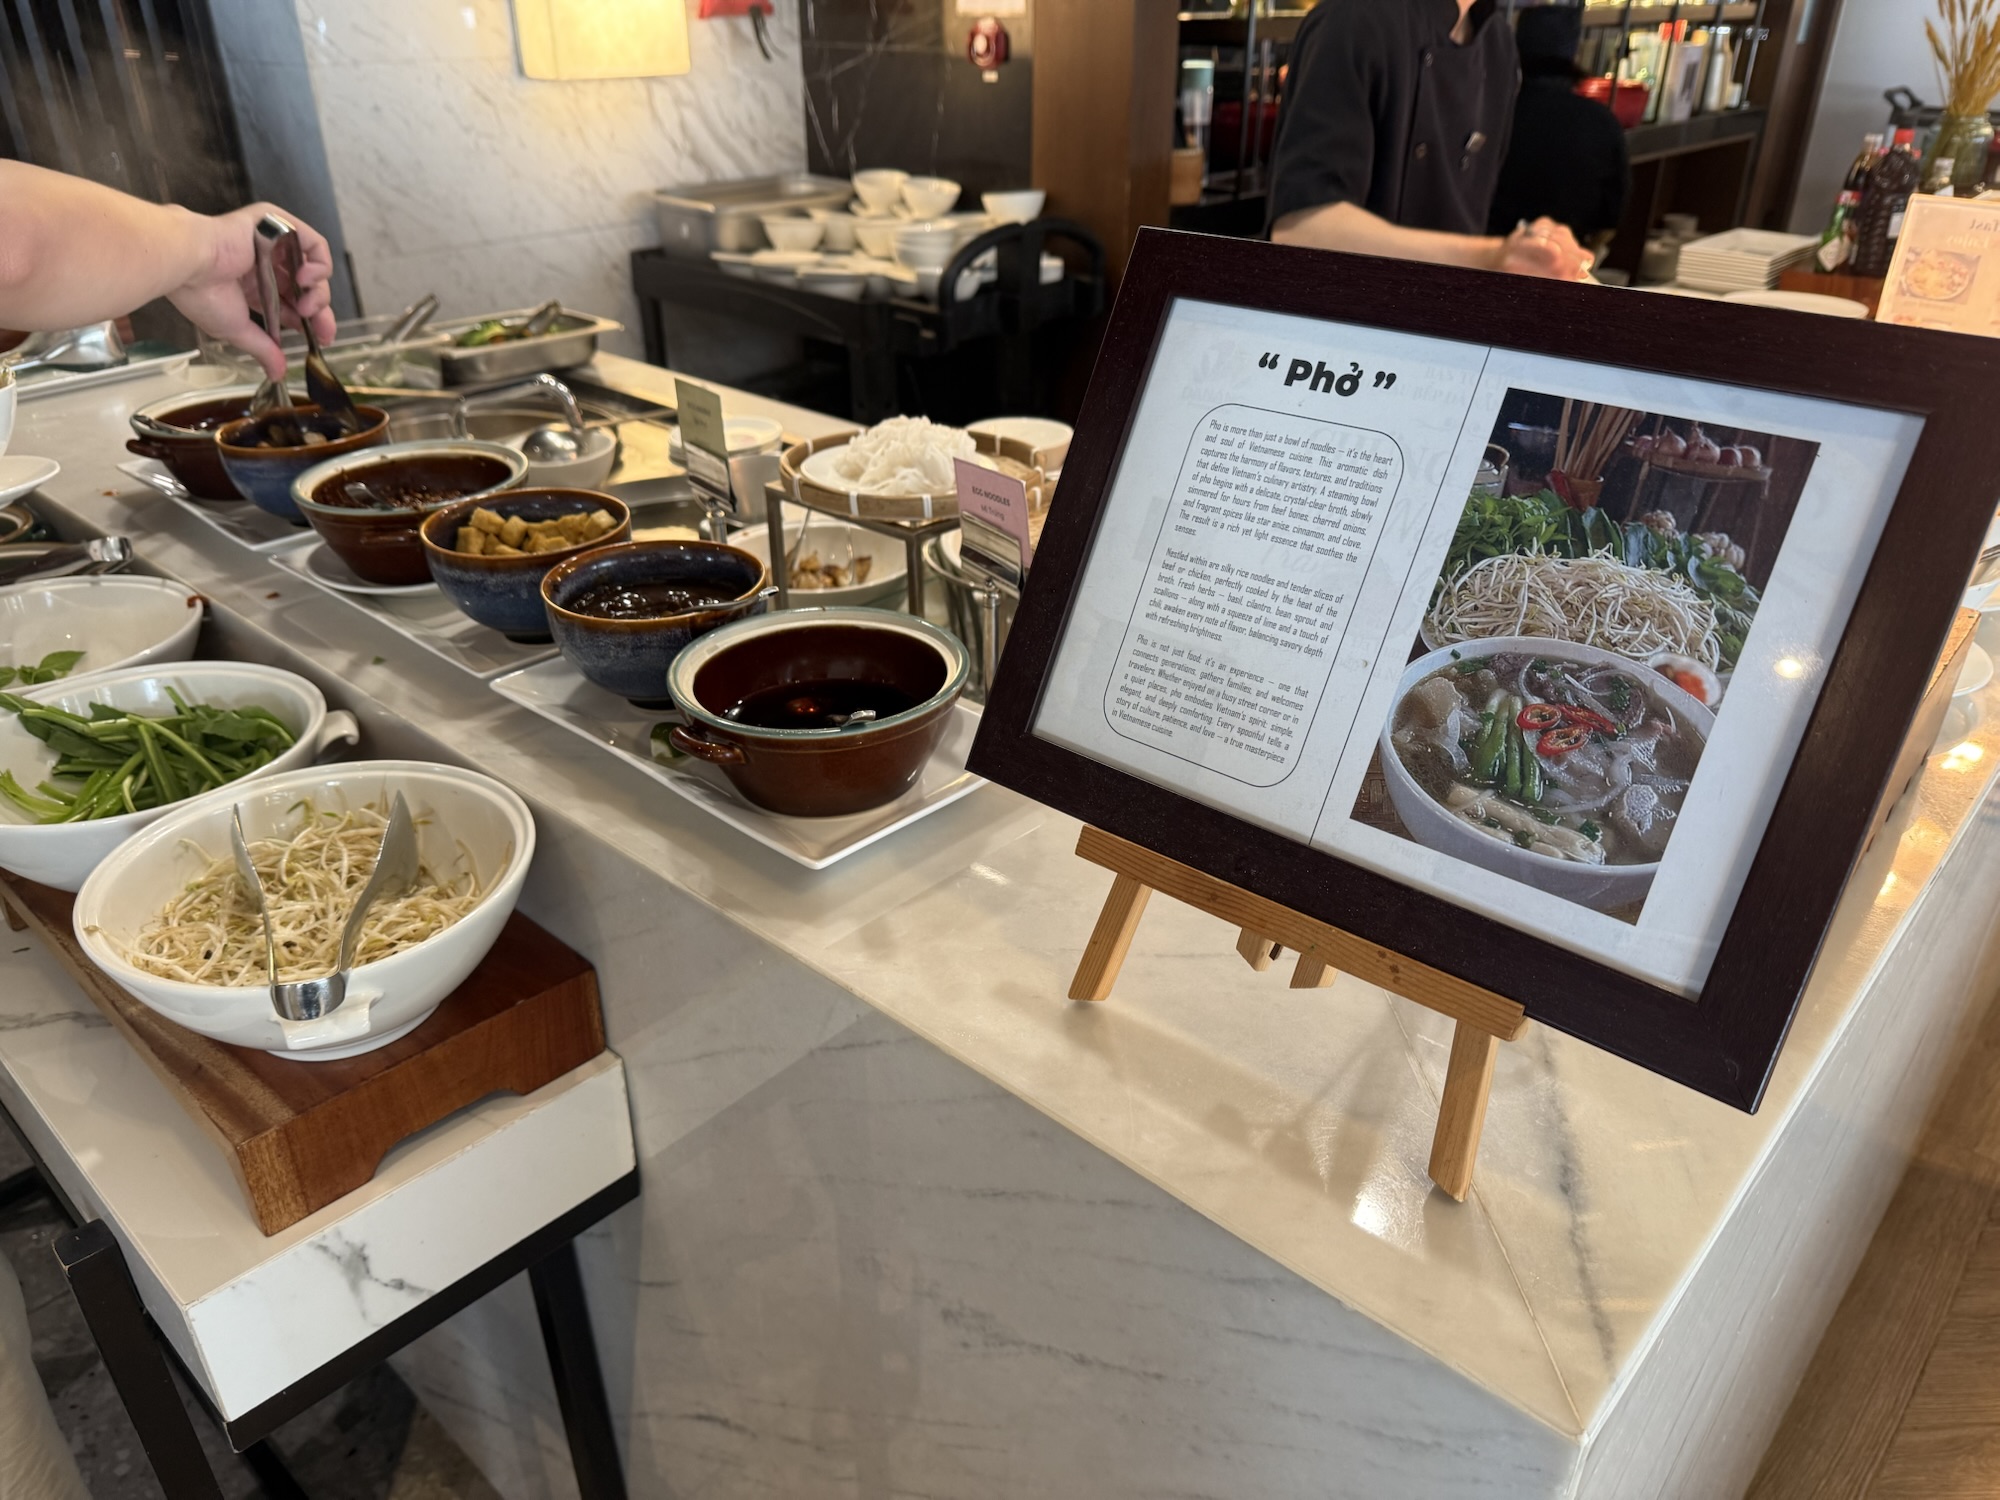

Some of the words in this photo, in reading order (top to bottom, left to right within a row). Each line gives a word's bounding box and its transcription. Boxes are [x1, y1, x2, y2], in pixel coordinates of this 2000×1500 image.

[1283, 358, 1364, 397] Phở
[1204, 433, 1218, 443] and
[1219, 437, 1235, 446] soul
[1248, 440, 1285, 458] Vietnamese
[1318, 455, 1332, 468] This
[1336, 462, 1368, 475] aromatic
[1372, 467, 1388, 479] dish
[1209, 418, 1221, 430] Pho
[1229, 426, 1247, 435] more
[1247, 427, 1263, 438] than
[1262, 431, 1277, 441] just
[1283, 434, 1301, 446] bowl
[1309, 442, 1336, 454] noodles
[1359, 449, 1371, 461] the
[1372, 452, 1393, 466] heart
[1195, 458, 1209, 469] that
[1210, 461, 1229, 474] define
[1262, 474, 1289, 489] culinary
[1326, 489, 1359, 505] steaming
[1360, 494, 1379, 507] bowl
[1200, 447, 1228, 459] captures
[1228, 451, 1239, 462] the
[1239, 453, 1268, 470] harmony
[1333, 475, 1349, 486] and
[1348, 478, 1383, 493] traditions
[971, 485, 984, 497] EGG
[984, 490, 1011, 508] NOODLES
[1182, 498, 1196, 507] and
[1195, 499, 1221, 514] fragrant
[1222, 508, 1243, 519] spices
[1243, 511, 1255, 522] like
[1255, 516, 1271, 526] star
[1327, 533, 1342, 543] and
[1187, 485, 1219, 499] simmered
[1219, 490, 1230, 502] for
[1231, 494, 1251, 507] hours
[1252, 499, 1269, 511] from
[1270, 503, 1287, 515] beef
[1312, 514, 1341, 528] charred
[1198, 473, 1211, 484] pho
[1212, 475, 1233, 489] begins
[1234, 482, 1248, 492] with
[1282, 494, 1326, 510] crystal-clear
[1350, 508, 1373, 523] slowly
[1178, 508, 1190, 520] The
[1191, 514, 1210, 525] result
[1226, 522, 1240, 533] rich
[1241, 527, 1252, 536] yet
[1253, 528, 1269, 540] light
[1270, 535, 1298, 548] essence
[1299, 539, 1314, 552] that
[1315, 546, 1343, 559] soothes
[1345, 551, 1357, 563] the
[1165, 547, 1189, 561] Nestled
[1189, 555, 1207, 566] within
[1207, 561, 1219, 570] are
[1220, 563, 1235, 576] silky
[1235, 567, 1249, 578] rice
[1249, 572, 1275, 585] noodles
[1275, 579, 1290, 589] and
[1289, 582, 1312, 595] tender
[1312, 588, 1334, 601] slices
[1213, 576, 1243, 592] perfectly
[1245, 585, 1269, 597] cooked
[1281, 593, 1294, 605] the
[1296, 597, 1312, 610] heat
[1325, 605, 1337, 617] the
[1145, 611, 1158, 620] with
[1157, 614, 1189, 632] refreshing
[1153, 586, 1179, 600] scallions
[1187, 595, 1205, 609] along
[1206, 602, 1219, 612] with
[1226, 608, 1253, 622] squeeze
[1277, 623, 1292, 633] and
[1298, 628, 1318, 641] touch
[1177, 577, 1195, 590] Fresh
[1197, 583, 1215, 597] herbs
[1274, 605, 1292, 619] bean
[1293, 614, 1317, 626] sprout
[1319, 621, 1334, 631] and
[1162, 603, 1186, 615] awaken
[1185, 610, 1204, 623] every
[1204, 616, 1219, 626] note
[1247, 626, 1279, 646] balancing
[1279, 639, 1303, 653] savory
[1303, 643, 1323, 658] depth
[1132, 648, 1159, 662] connects
[1198, 671, 1224, 684] gathers
[1255, 689, 1269, 699] and
[1270, 694, 1303, 711] welcomes
[1136, 633, 1148, 645] Pho
[1159, 643, 1170, 652] not
[1171, 648, 1184, 657] just
[1229, 666, 1264, 683] experience
[1277, 682, 1291, 692] one
[1293, 685, 1308, 698] that
[1130, 675, 1146, 685] quiet
[1183, 694, 1213, 709] embodies
[1157, 668, 1182, 683] Whether
[1182, 679, 1207, 692] enjoyed
[1220, 689, 1237, 705] busy
[1237, 697, 1258, 710] street
[1258, 705, 1281, 717] corner
[1115, 696, 1131, 709] story
[1189, 724, 1202, 733] and
[1201, 725, 1215, 738] love
[1229, 737, 1243, 748] true
[1243, 743, 1285, 763] masterpiece
[1144, 693, 1157, 703] and
[1158, 696, 1177, 712] deeply
[1216, 716, 1235, 732] Every
[1236, 726, 1265, 741] spoonful
[1266, 735, 1282, 747] tells
